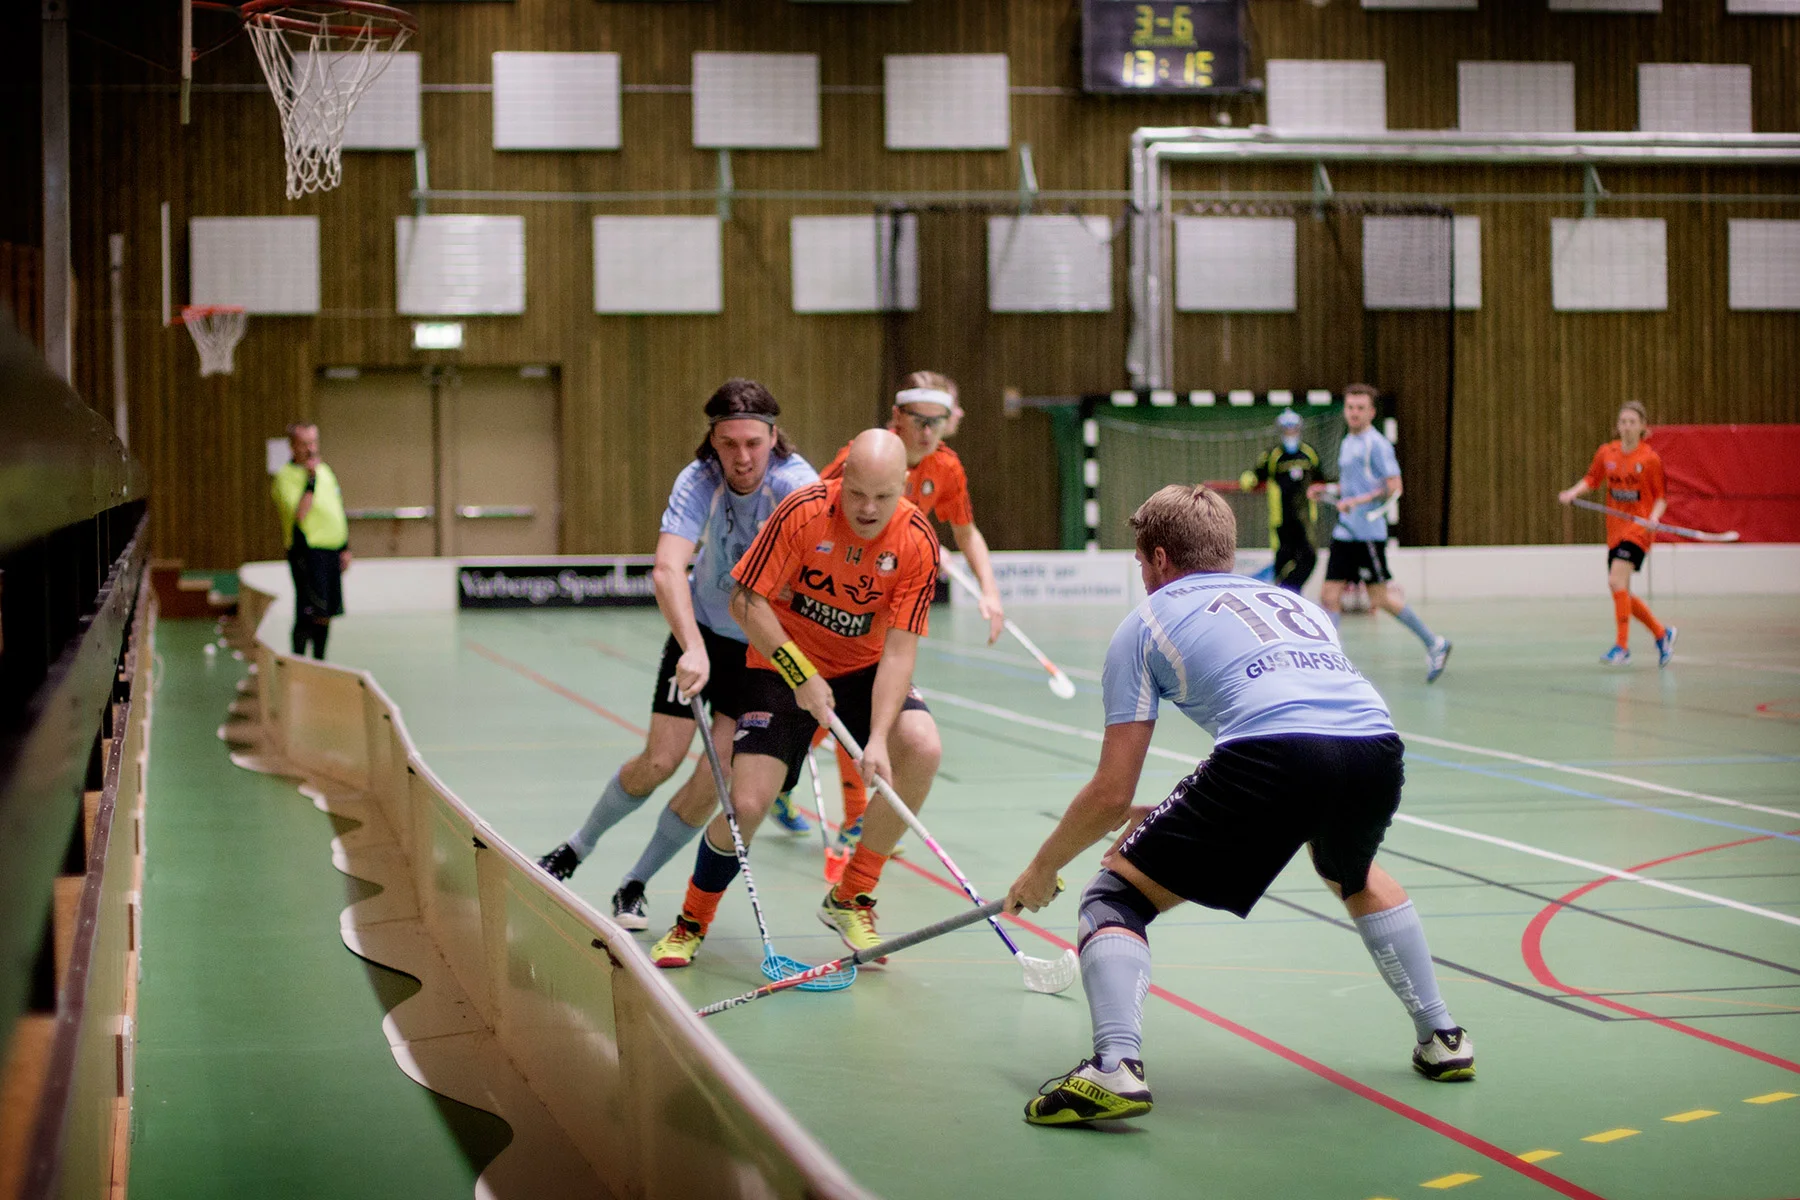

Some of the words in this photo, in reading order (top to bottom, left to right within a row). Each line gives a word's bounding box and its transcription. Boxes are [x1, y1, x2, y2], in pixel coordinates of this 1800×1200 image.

[845, 545, 863, 566] 14
[799, 564, 837, 597] ICA
[857, 574, 875, 590] SJ
[800, 607, 863, 637] HAIRCARE
[803, 595, 865, 629] VISION
[1205, 590, 1331, 646] 18
[1246, 649, 1362, 680] GUSTAFSSO
[1374, 942, 1425, 1014] SALMING
[1063, 1077, 1112, 1101] SALMI
